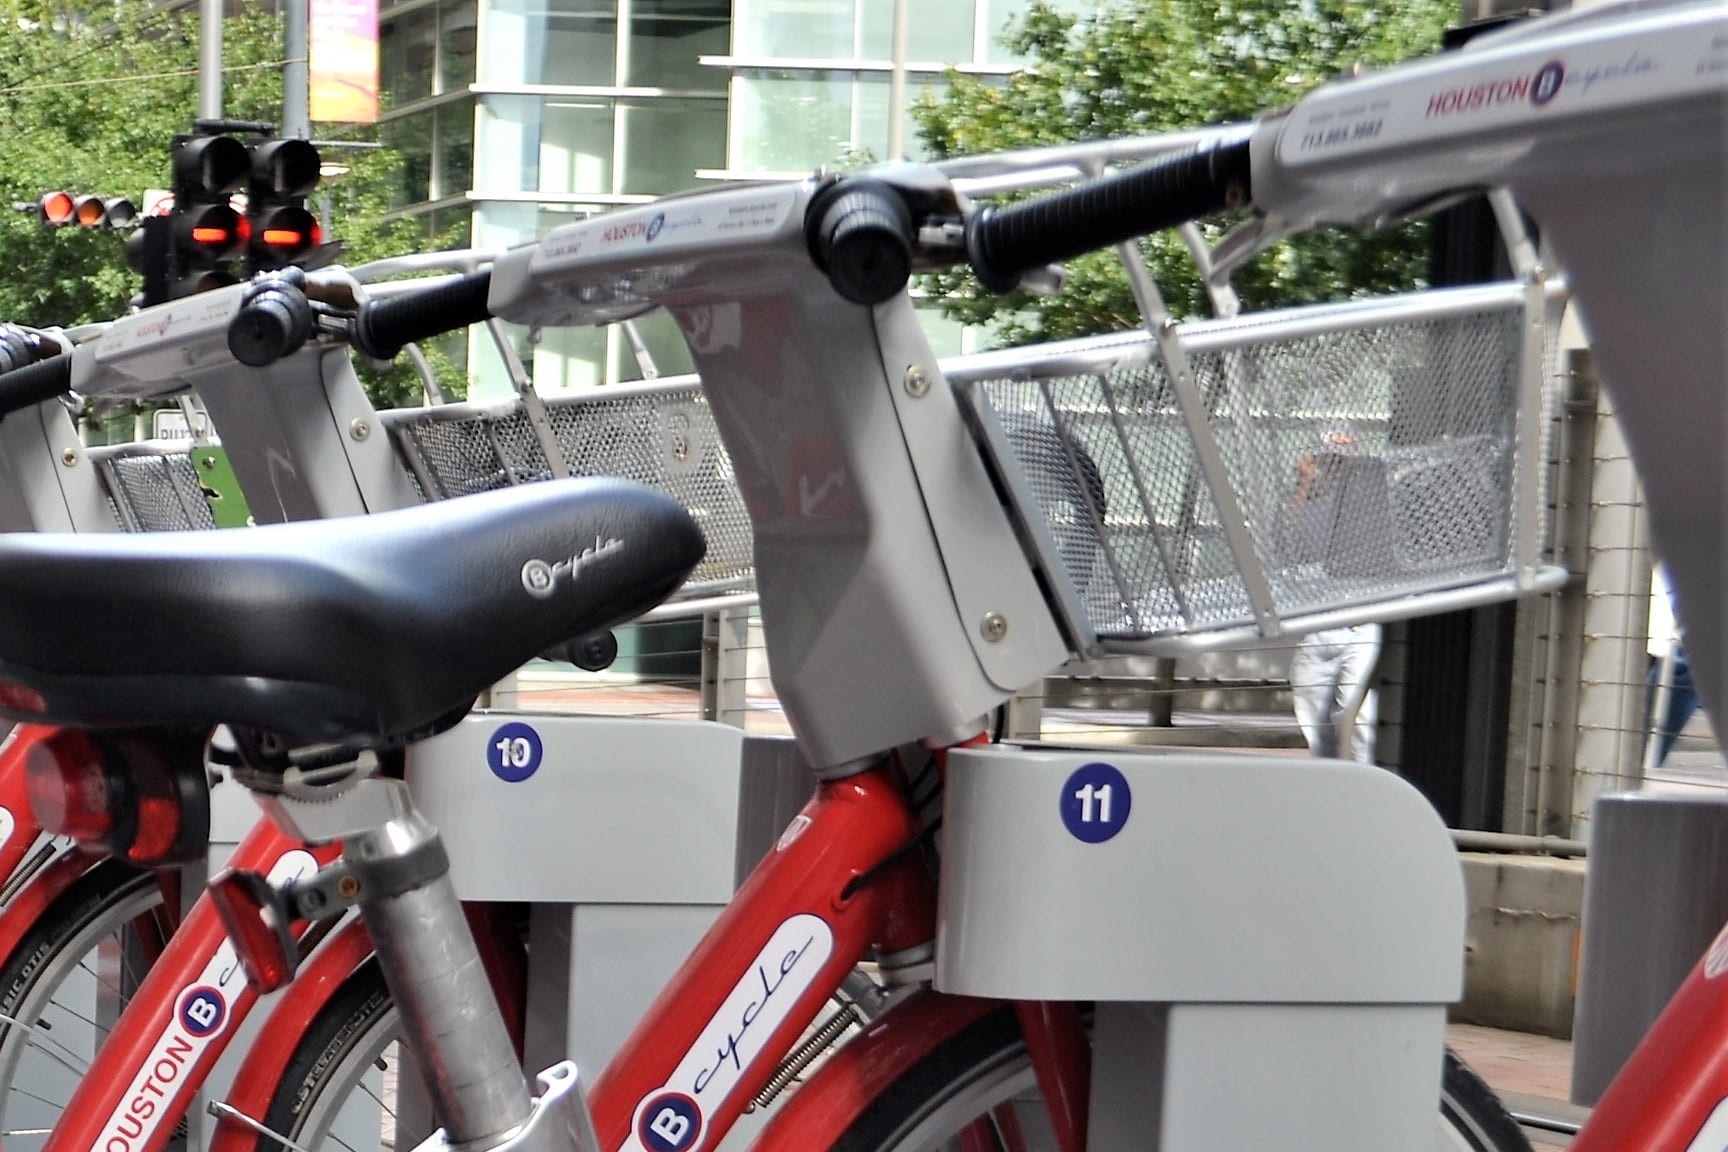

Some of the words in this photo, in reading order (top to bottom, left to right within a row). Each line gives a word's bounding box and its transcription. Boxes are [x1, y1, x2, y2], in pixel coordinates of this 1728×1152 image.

[1425, 80, 1530, 119] HOUSTON
[496, 737, 531, 768] 10
[1075, 783, 1112, 822] 11
[693, 935, 814, 1095] cycle
